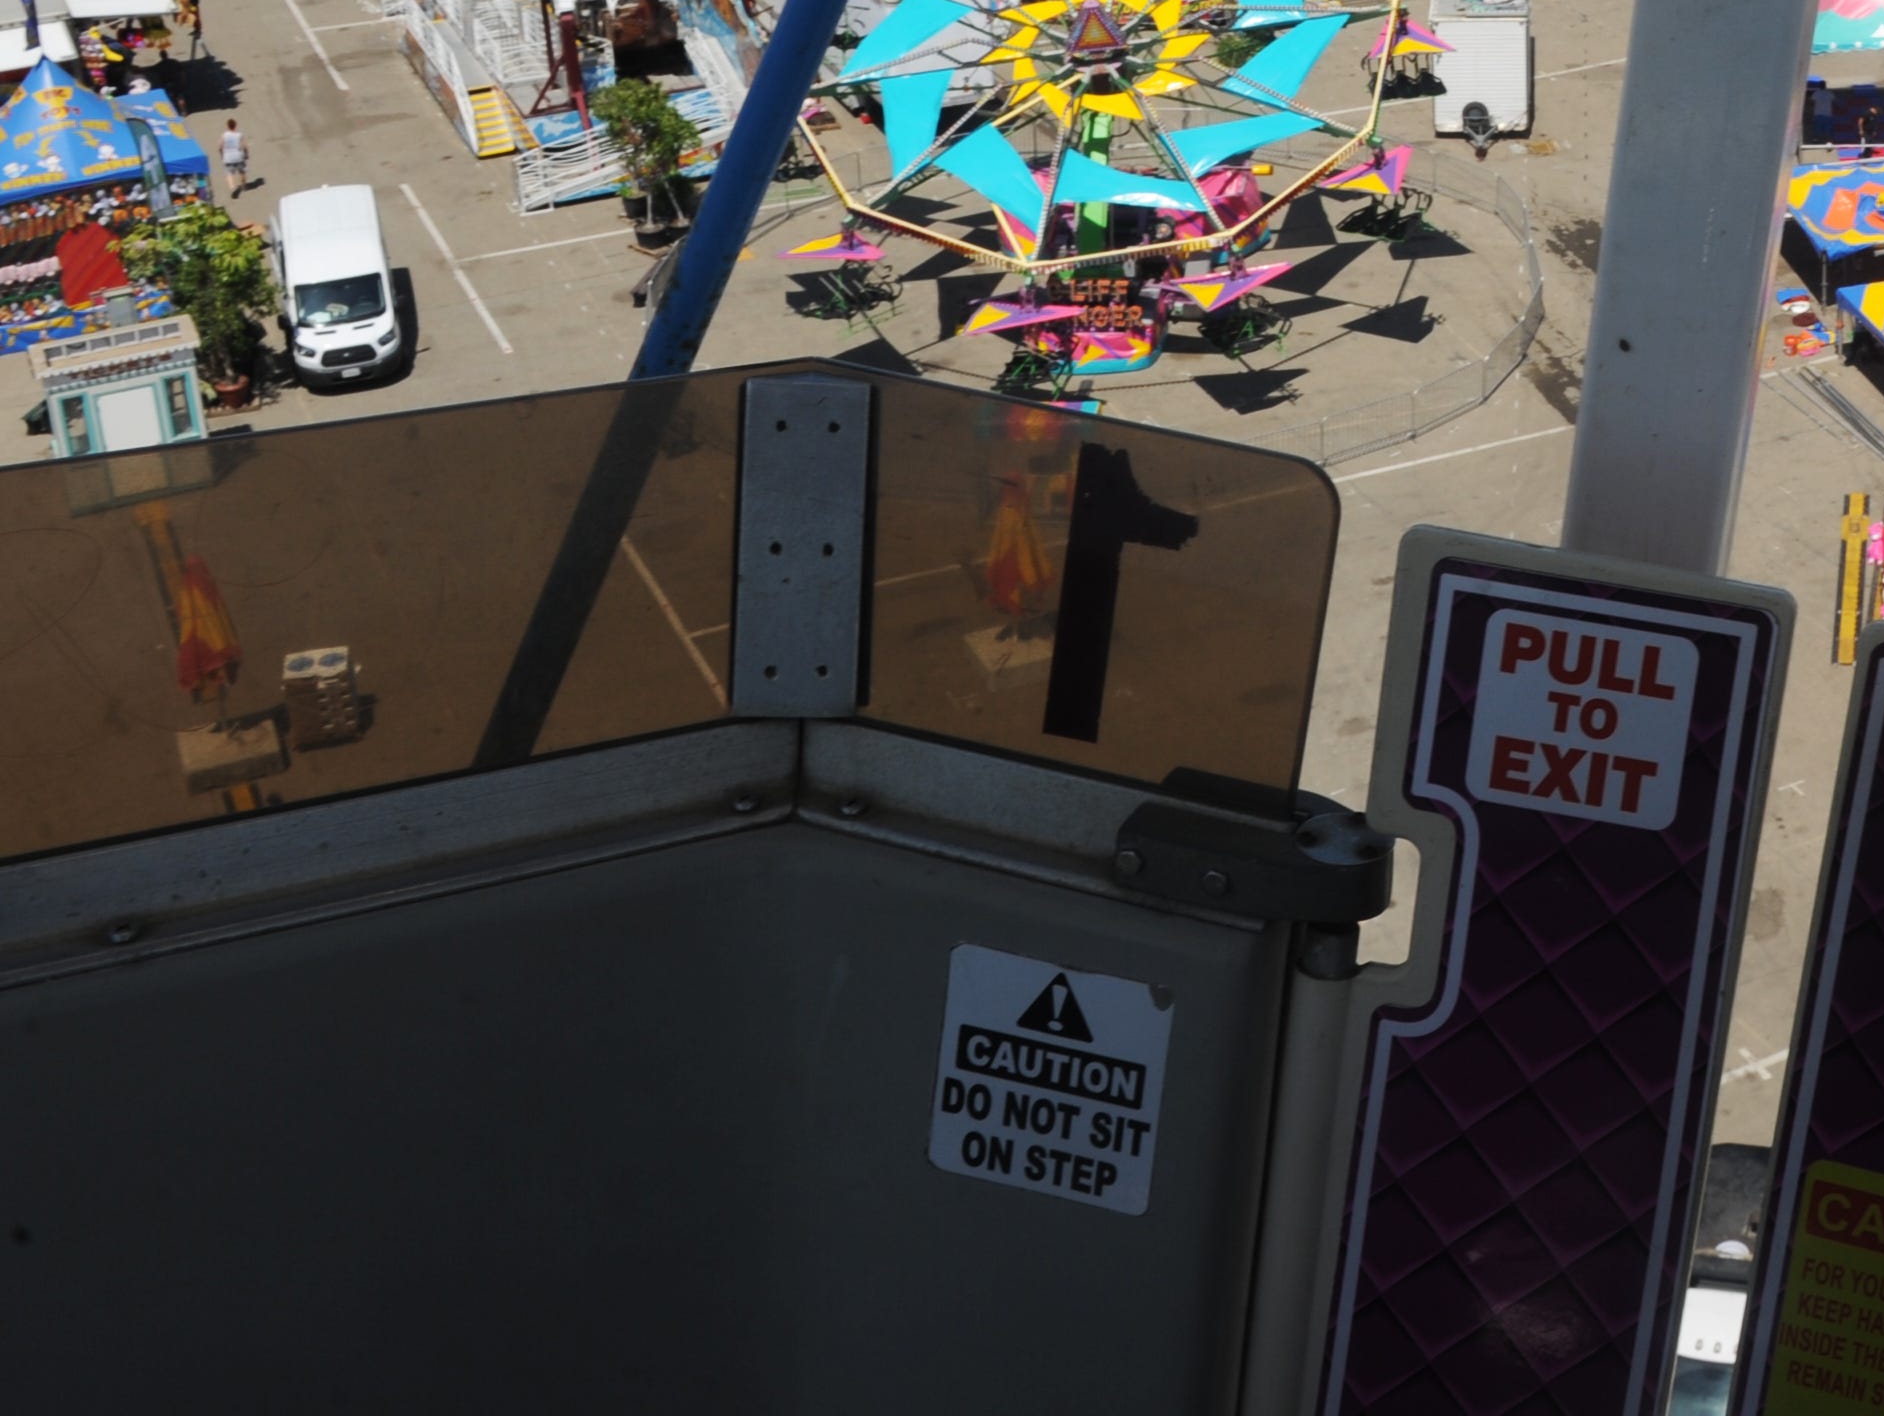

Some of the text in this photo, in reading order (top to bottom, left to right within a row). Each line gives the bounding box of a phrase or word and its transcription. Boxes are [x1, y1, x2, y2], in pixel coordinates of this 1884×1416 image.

[1073, 304, 1143, 328] NGER
[1500, 622, 1675, 700] PULL
[1548, 691, 1619, 740] TO
[1489, 735, 1658, 813] EXIT
[966, 1035, 1138, 1102] CAUTION
[941, 1077, 1150, 1157] DO NOT SIT
[961, 1131, 1118, 1197] ON STEP
[1801, 1258, 1846, 1289] FOR
[1797, 1292, 1853, 1325] KEEP
[1778, 1324, 1847, 1361] INSIDE
[1787, 1361, 1867, 1401] REMAIN
